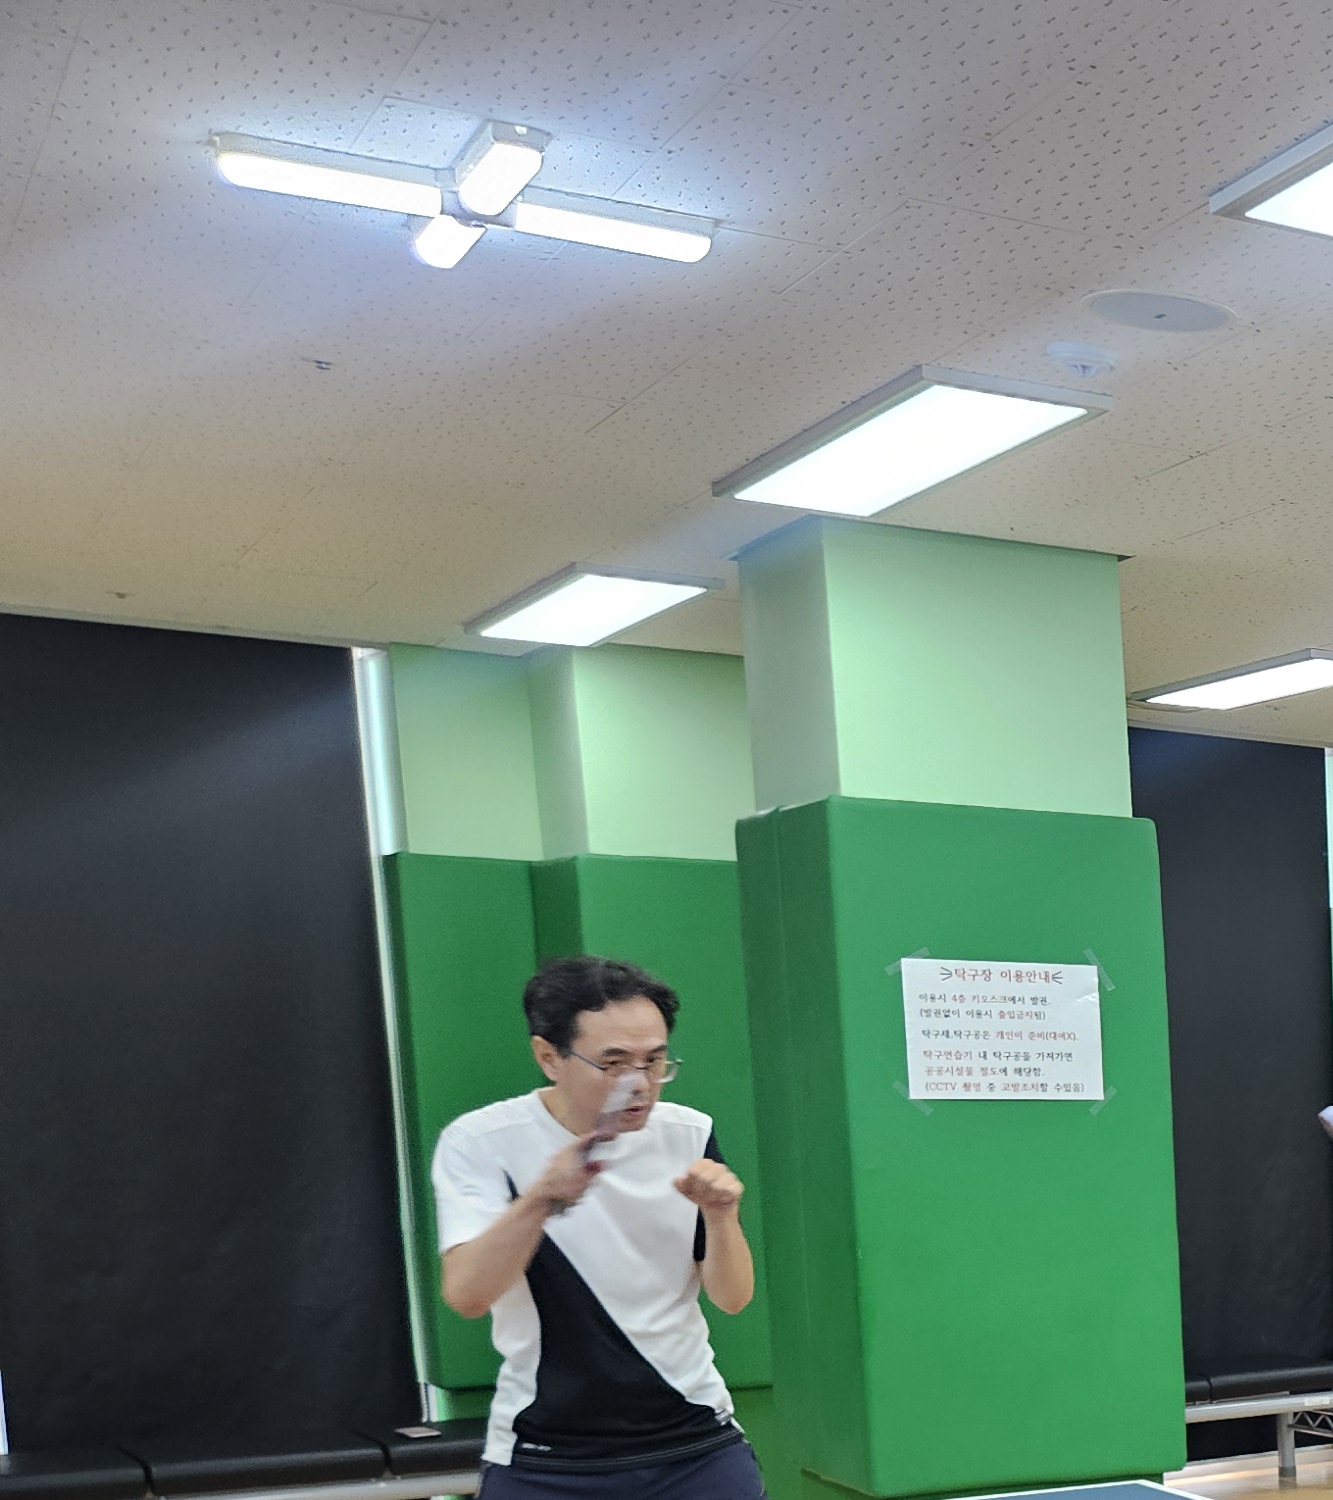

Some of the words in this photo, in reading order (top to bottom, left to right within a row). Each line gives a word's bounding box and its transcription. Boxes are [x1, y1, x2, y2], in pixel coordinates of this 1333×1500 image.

[954, 968, 992, 982] 탁구장
[1000, 970, 1050, 984] 이용안내
[918, 993, 947, 1004] 이용시
[951, 994, 966, 1005] 4층
[965, 1008, 993, 1019] 이용시
[995, 1030, 1023, 1041] 개인이
[922, 1050, 973, 1061] 탁구연습기
[978, 1051, 988, 1060] 내
[993, 1051, 1031, 1061] 탁구공을
[925, 1065, 974, 1076] 공공시설물
[925, 1082, 957, 1091] (CCTV
[962, 1082, 981, 1092] 촬영
[987, 1082, 997, 1092] 중
